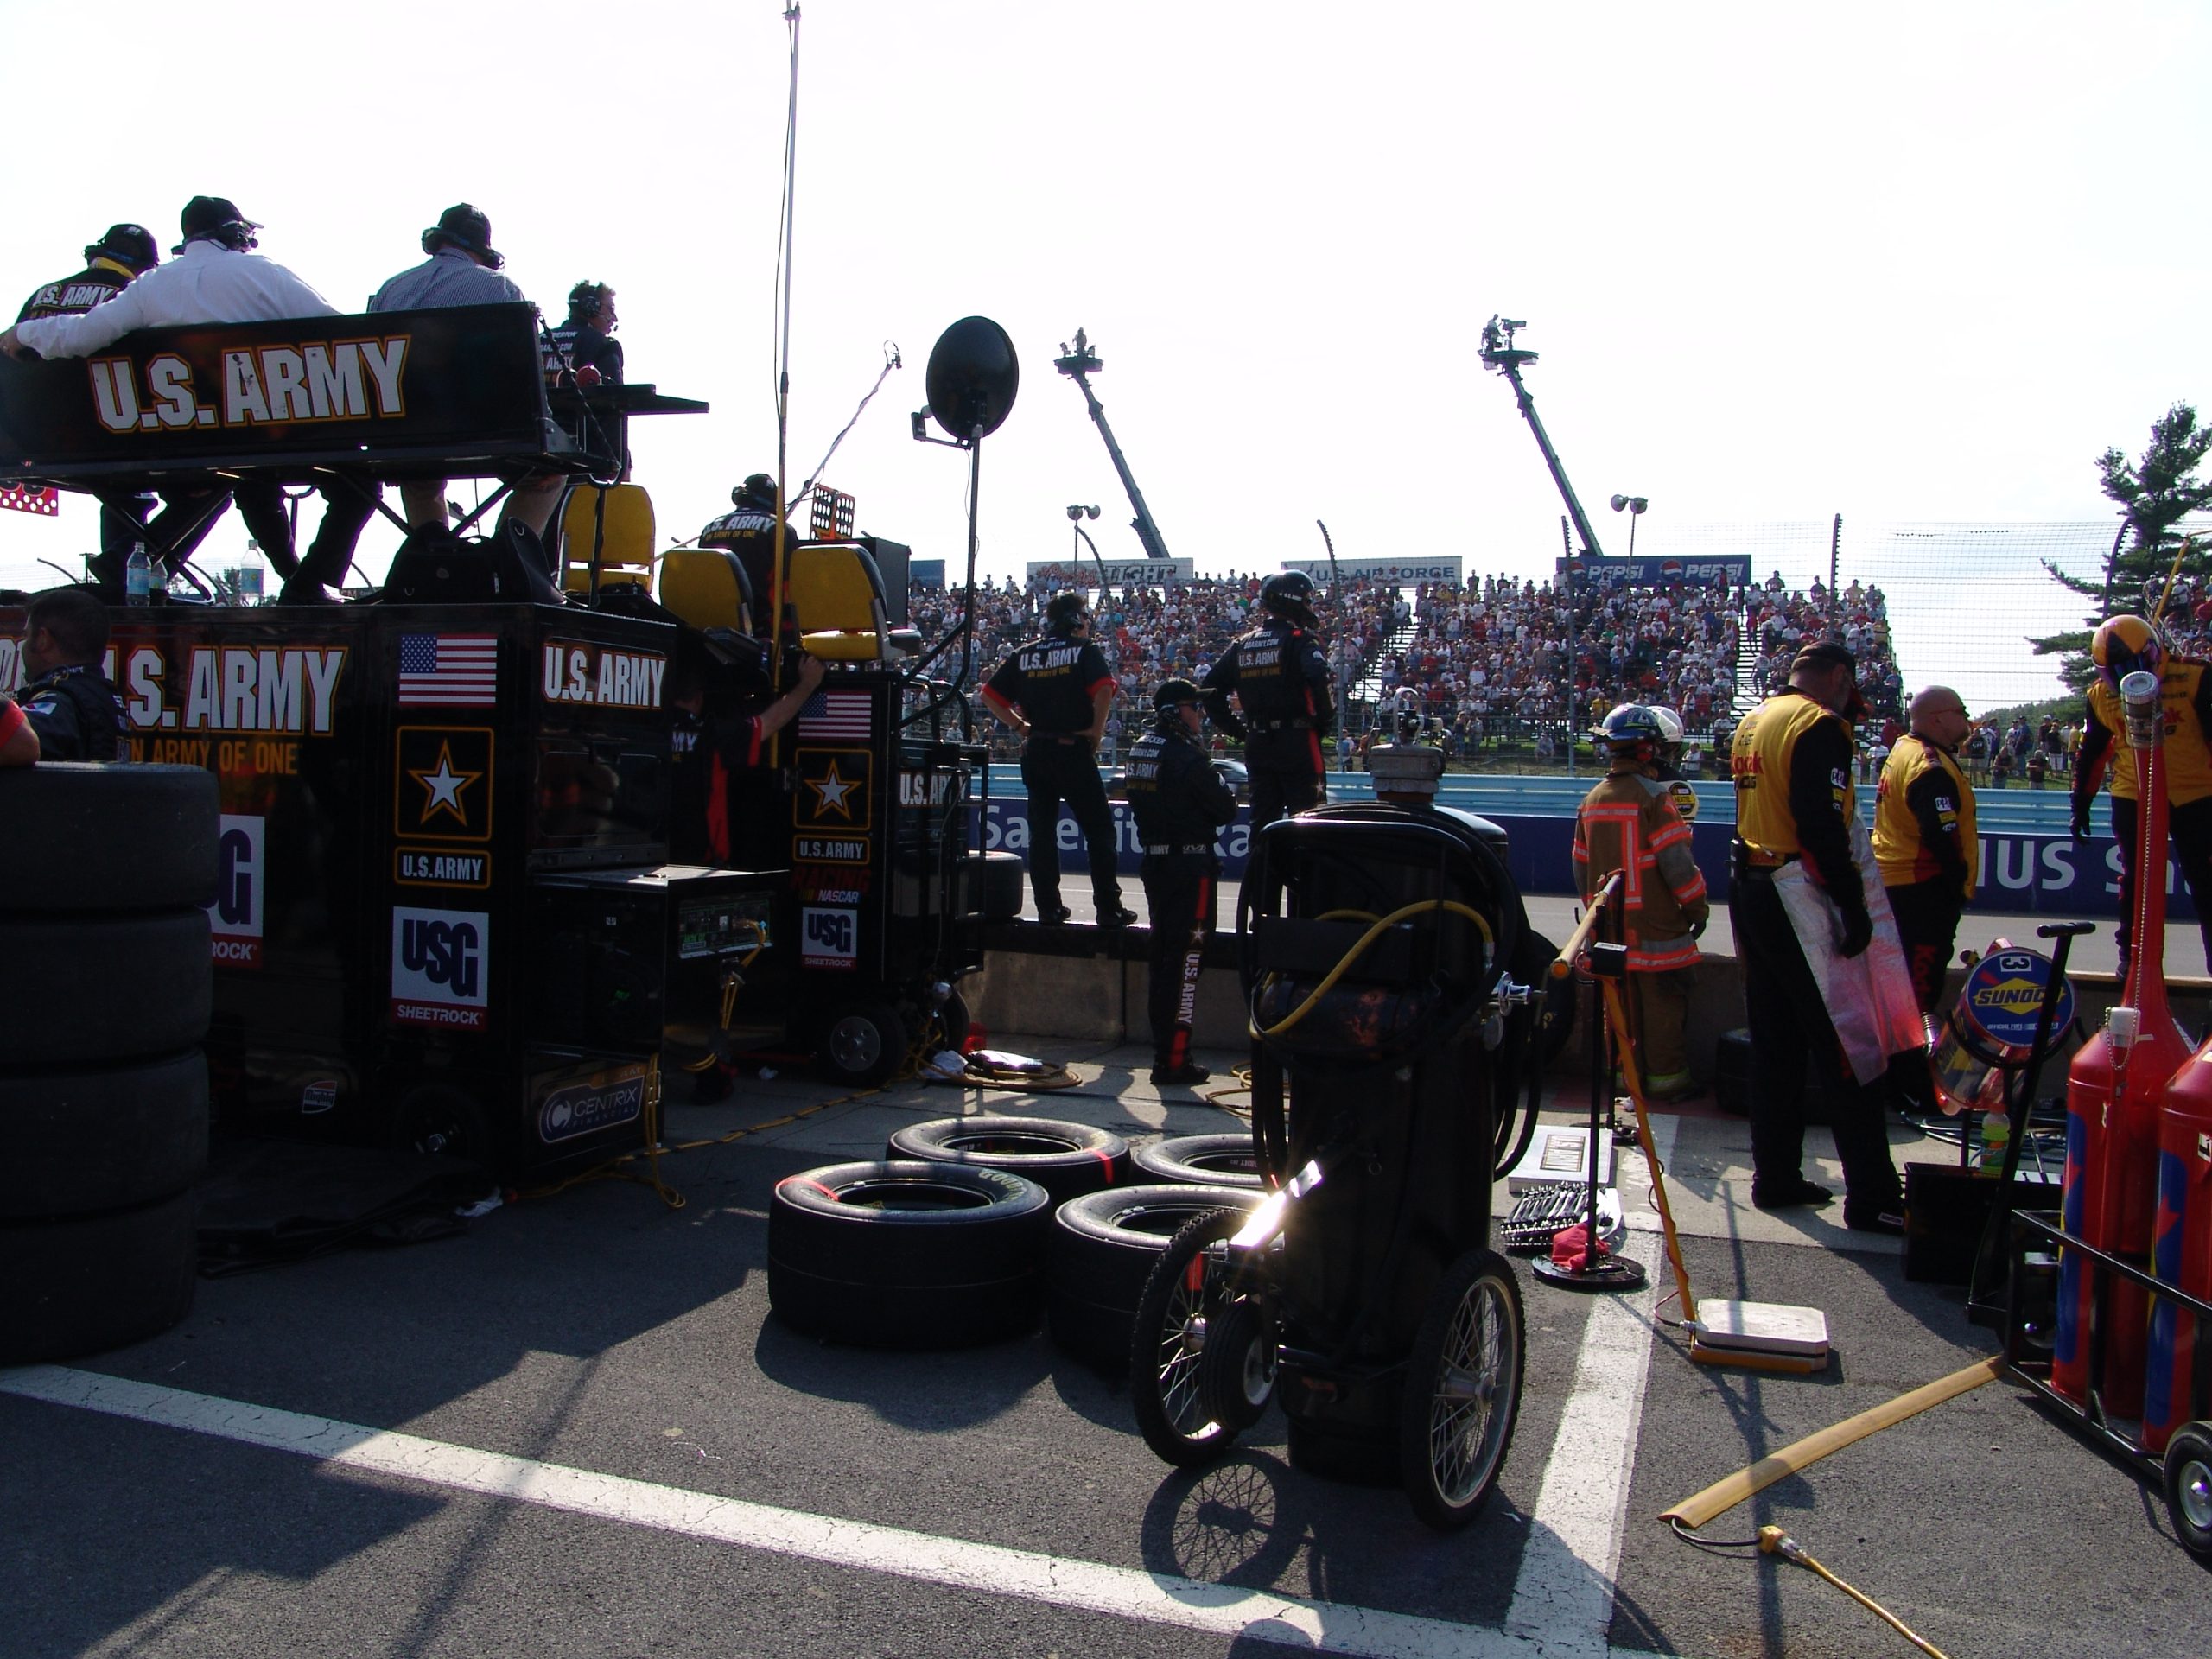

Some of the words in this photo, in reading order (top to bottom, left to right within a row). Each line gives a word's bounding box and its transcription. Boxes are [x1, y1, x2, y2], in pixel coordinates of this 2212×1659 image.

[60, 285, 115, 307] ARMY
[92, 356, 217, 431] U.S.
[224, 339, 408, 423] ARMY
[725, 515, 777, 533] ARMY
[1104, 564, 1177, 585] LIGHT
[1587, 564, 1645, 580] PEPSI
[1019, 652, 1044, 671] U.S.
[1045, 646, 1083, 670] ARMY
[1238, 654, 1254, 667] U.S.
[1255, 650, 1280, 665] ARMY
[544, 646, 594, 702] U.S.
[597, 653, 665, 708] ARMY
[185, 649, 343, 733] ARMY
[671, 732, 698, 751] MY
[151, 739, 211, 767] ARMY
[219, 741, 249, 769] OF
[255, 741, 298, 774] ONE
[1136, 763, 1159, 779] ARMY
[899, 773, 927, 805] U.S.
[929, 774, 968, 805] ARY
[1975, 838, 2076, 891] IUS
[817, 889, 860, 904] NASCAR
[808, 914, 851, 953] USG
[403, 918, 479, 997] USG
[804, 957, 852, 968] SHEETROCK
[1184, 953, 1201, 982] U.S.
[2001, 957, 2031, 970] 3
[1178, 982, 1197, 1024] ARMY
[1979, 988, 2047, 1005] SUNOC
[397, 1004, 480, 1026] SHEETROCK
[574, 1086, 638, 1117] CENTRIX
